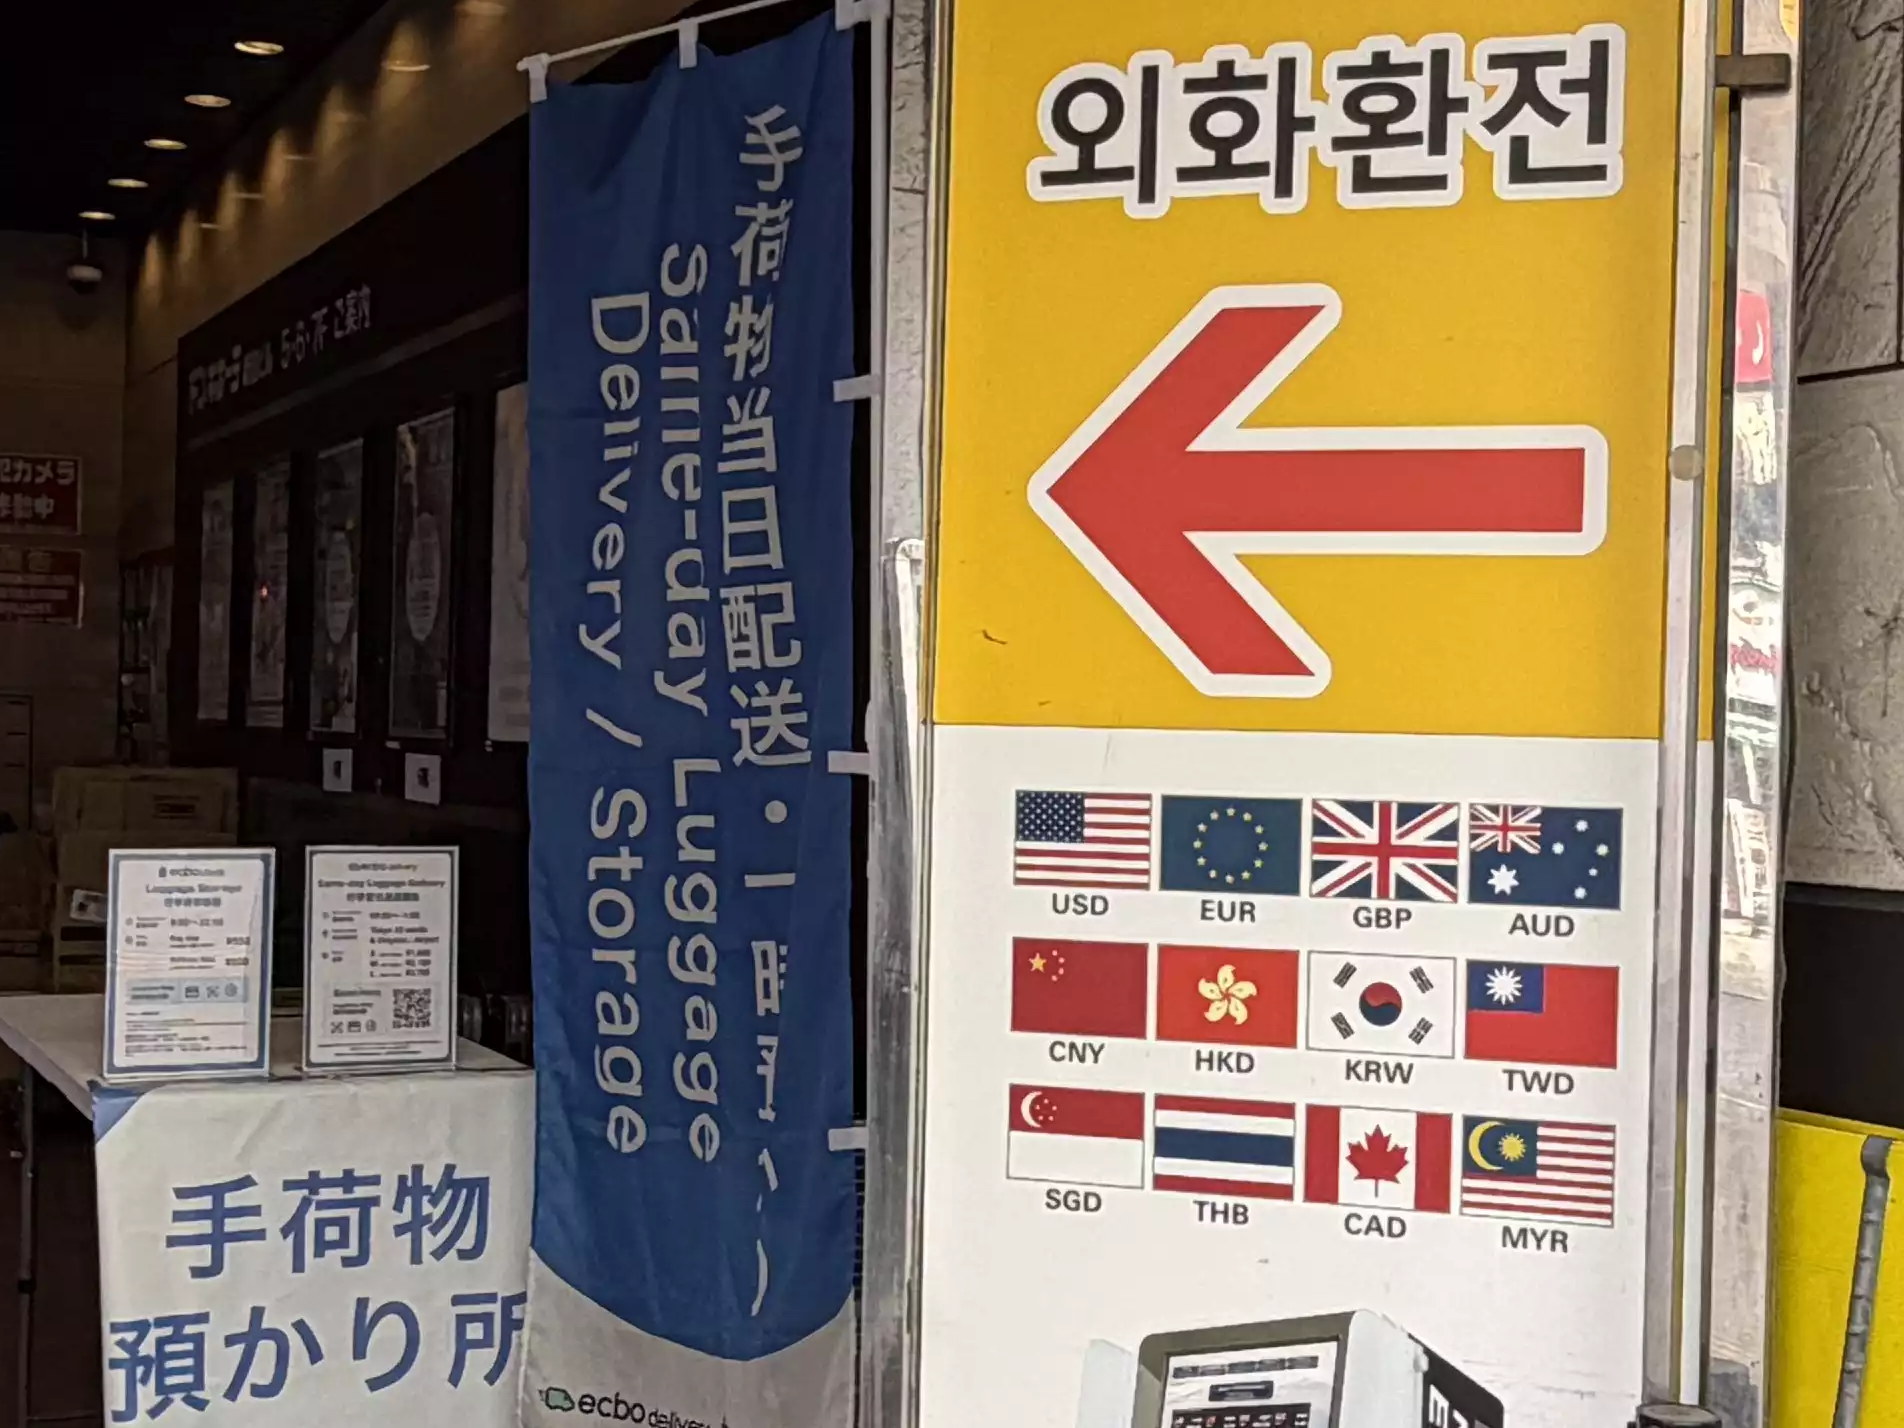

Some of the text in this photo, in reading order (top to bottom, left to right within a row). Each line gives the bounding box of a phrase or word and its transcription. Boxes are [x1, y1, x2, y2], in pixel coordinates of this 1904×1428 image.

[1039, 38, 1611, 205] 외화환전
[579, 291, 651, 670] Delivery
[654, 241, 722, 1164] Same-day Luggage
[1051, 894, 1109, 917] USD
[1200, 899, 1256, 923] EUR
[1352, 906, 1412, 930] GBP
[1508, 913, 1575, 938] AUD
[587, 785, 648, 1154] Storage
[1048, 1040, 1105, 1065] CNY
[1195, 1050, 1254, 1074] HKD
[1345, 1059, 1414, 1084] KRW
[1503, 1069, 1574, 1095] TWD
[1045, 1188, 1102, 1213] SGD
[1193, 1200, 1249, 1225] THB
[164, 1163, 491, 1280] 手荷物
[1343, 1212, 1407, 1238] CAD
[1500, 1226, 1569, 1252] MYR
[108, 1290, 529, 1424] 預かり所
[578, 1392, 646, 1424] ecbo
